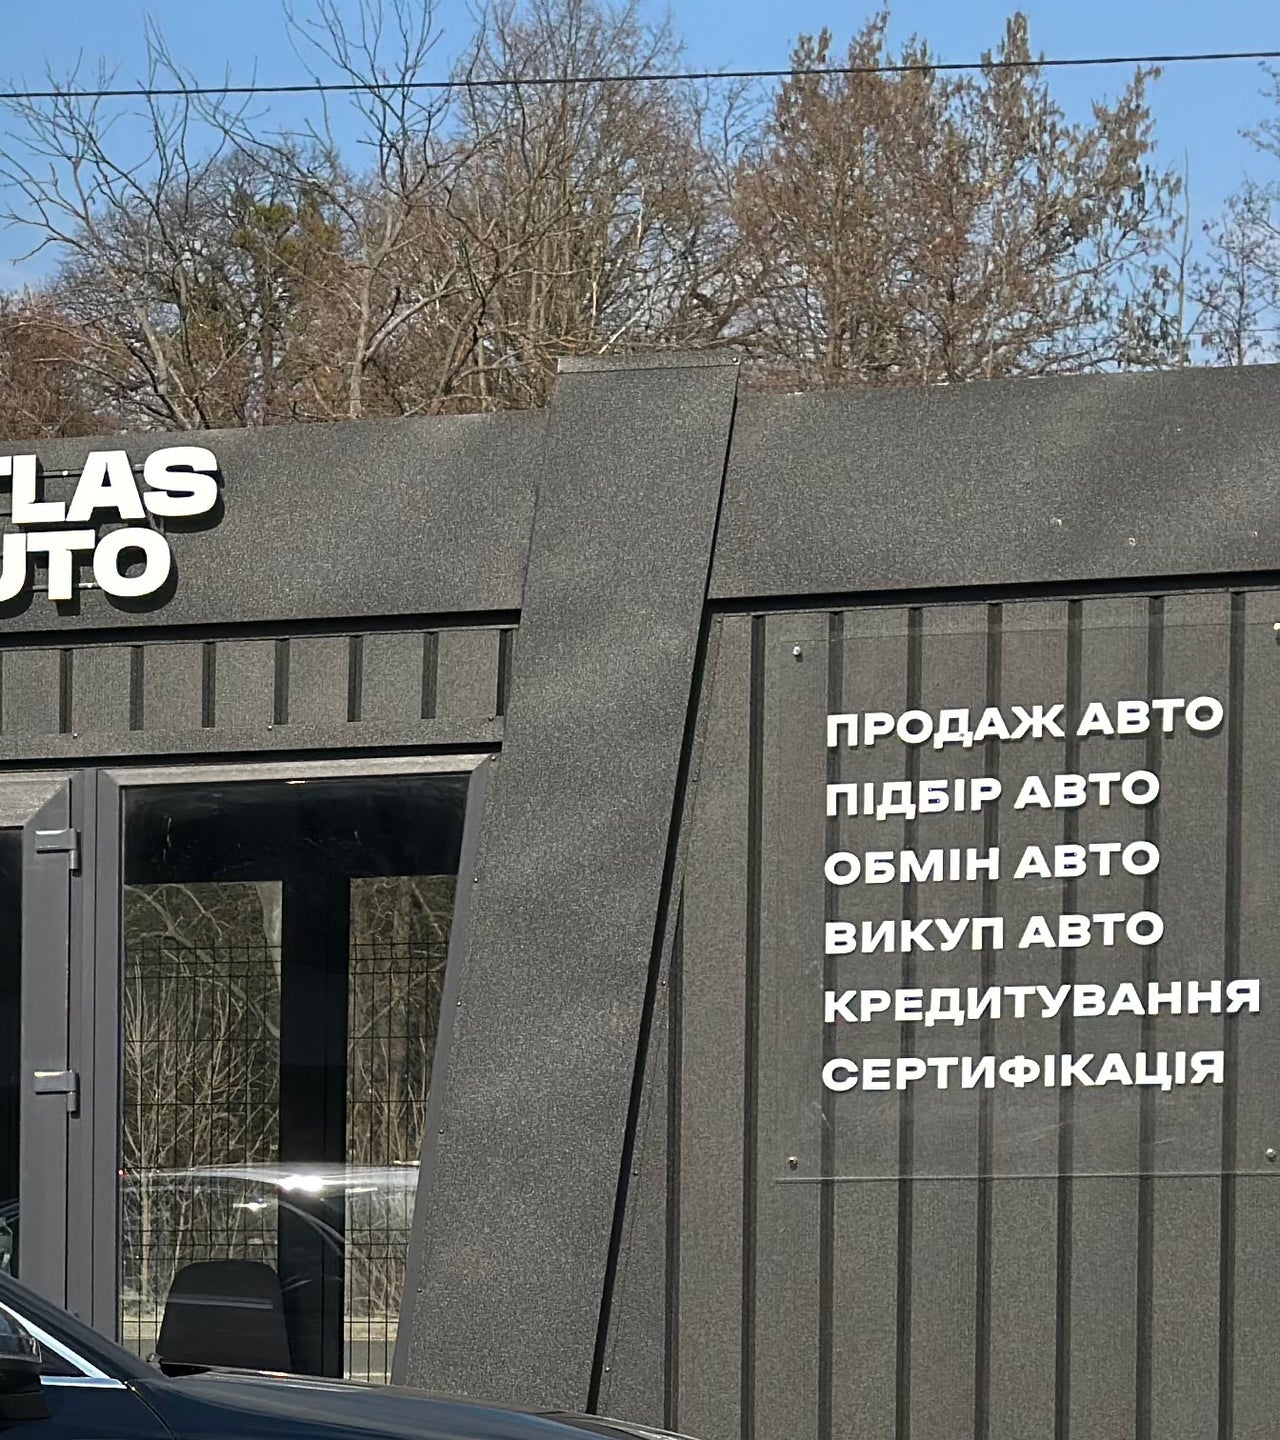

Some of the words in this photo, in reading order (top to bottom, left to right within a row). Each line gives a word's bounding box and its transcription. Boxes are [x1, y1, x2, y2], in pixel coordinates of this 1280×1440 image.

[826, 703, 1066, 750] ПРОДАЖ
[1076, 696, 1224, 736] АВТО
[826, 777, 1002, 821] ПІДБІР
[1013, 769, 1160, 810] АВТО
[824, 847, 1000, 886] ОБМІН
[1013, 840, 1160, 879] АВТО
[824, 916, 1004, 955] ВИКУП
[1018, 911, 1164, 949] АВТО
[824, 978, 1260, 1027] КРЕДИТУВАННЯ
[821, 1050, 1225, 1092] СЕРТИФІКАЦІЯ
